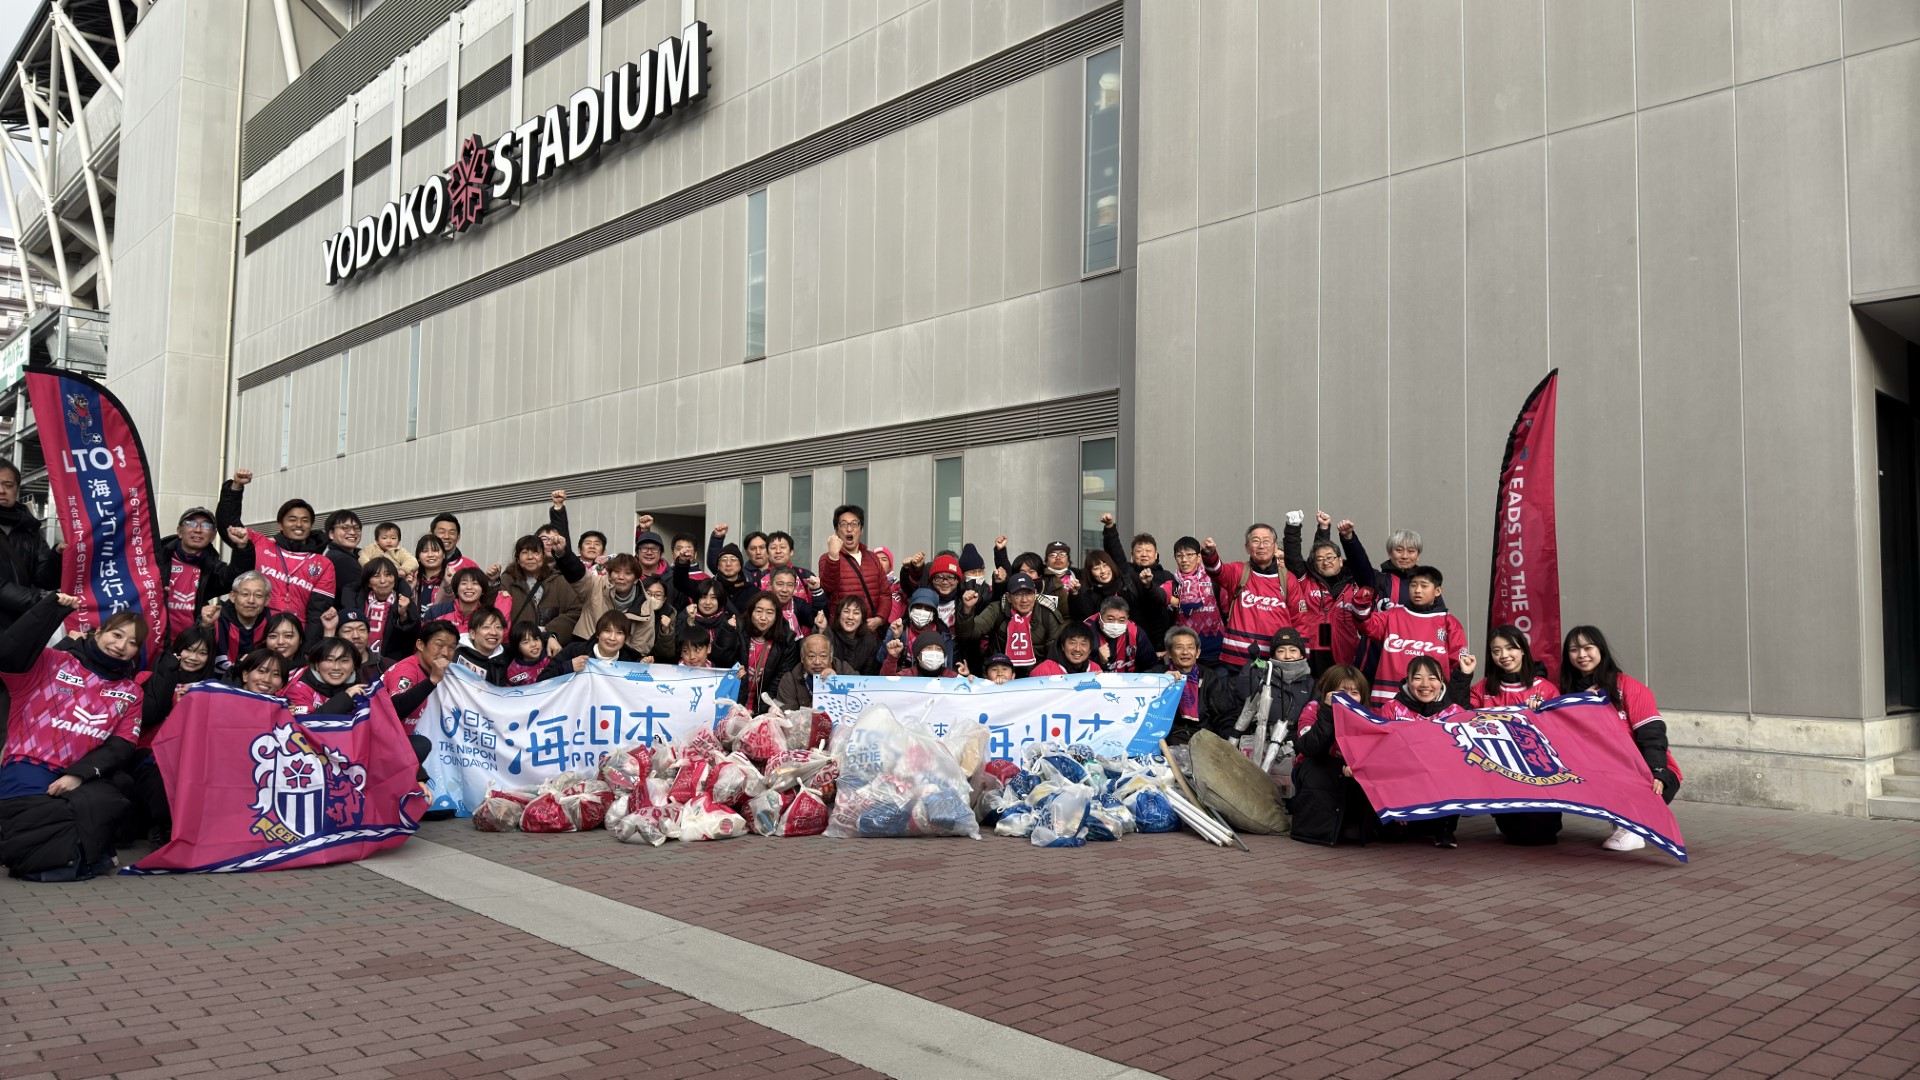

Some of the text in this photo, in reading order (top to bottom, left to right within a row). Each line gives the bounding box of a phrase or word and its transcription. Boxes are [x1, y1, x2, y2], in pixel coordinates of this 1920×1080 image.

[322, 20, 707, 286] YODOKO STADIUM
[62, 447, 114, 473] LTO
[1508, 537, 1524, 567] TO
[261, 565, 314, 592] YANMAR
[1511, 571, 1530, 612] THE
[1011, 632, 1028, 650] 25
[464, 709, 494, 731] 日本
[439, 741, 497, 762] THE NIPPON
[505, 705, 671, 775] 海と日本
[439, 755, 498, 772] FOUNDATION
